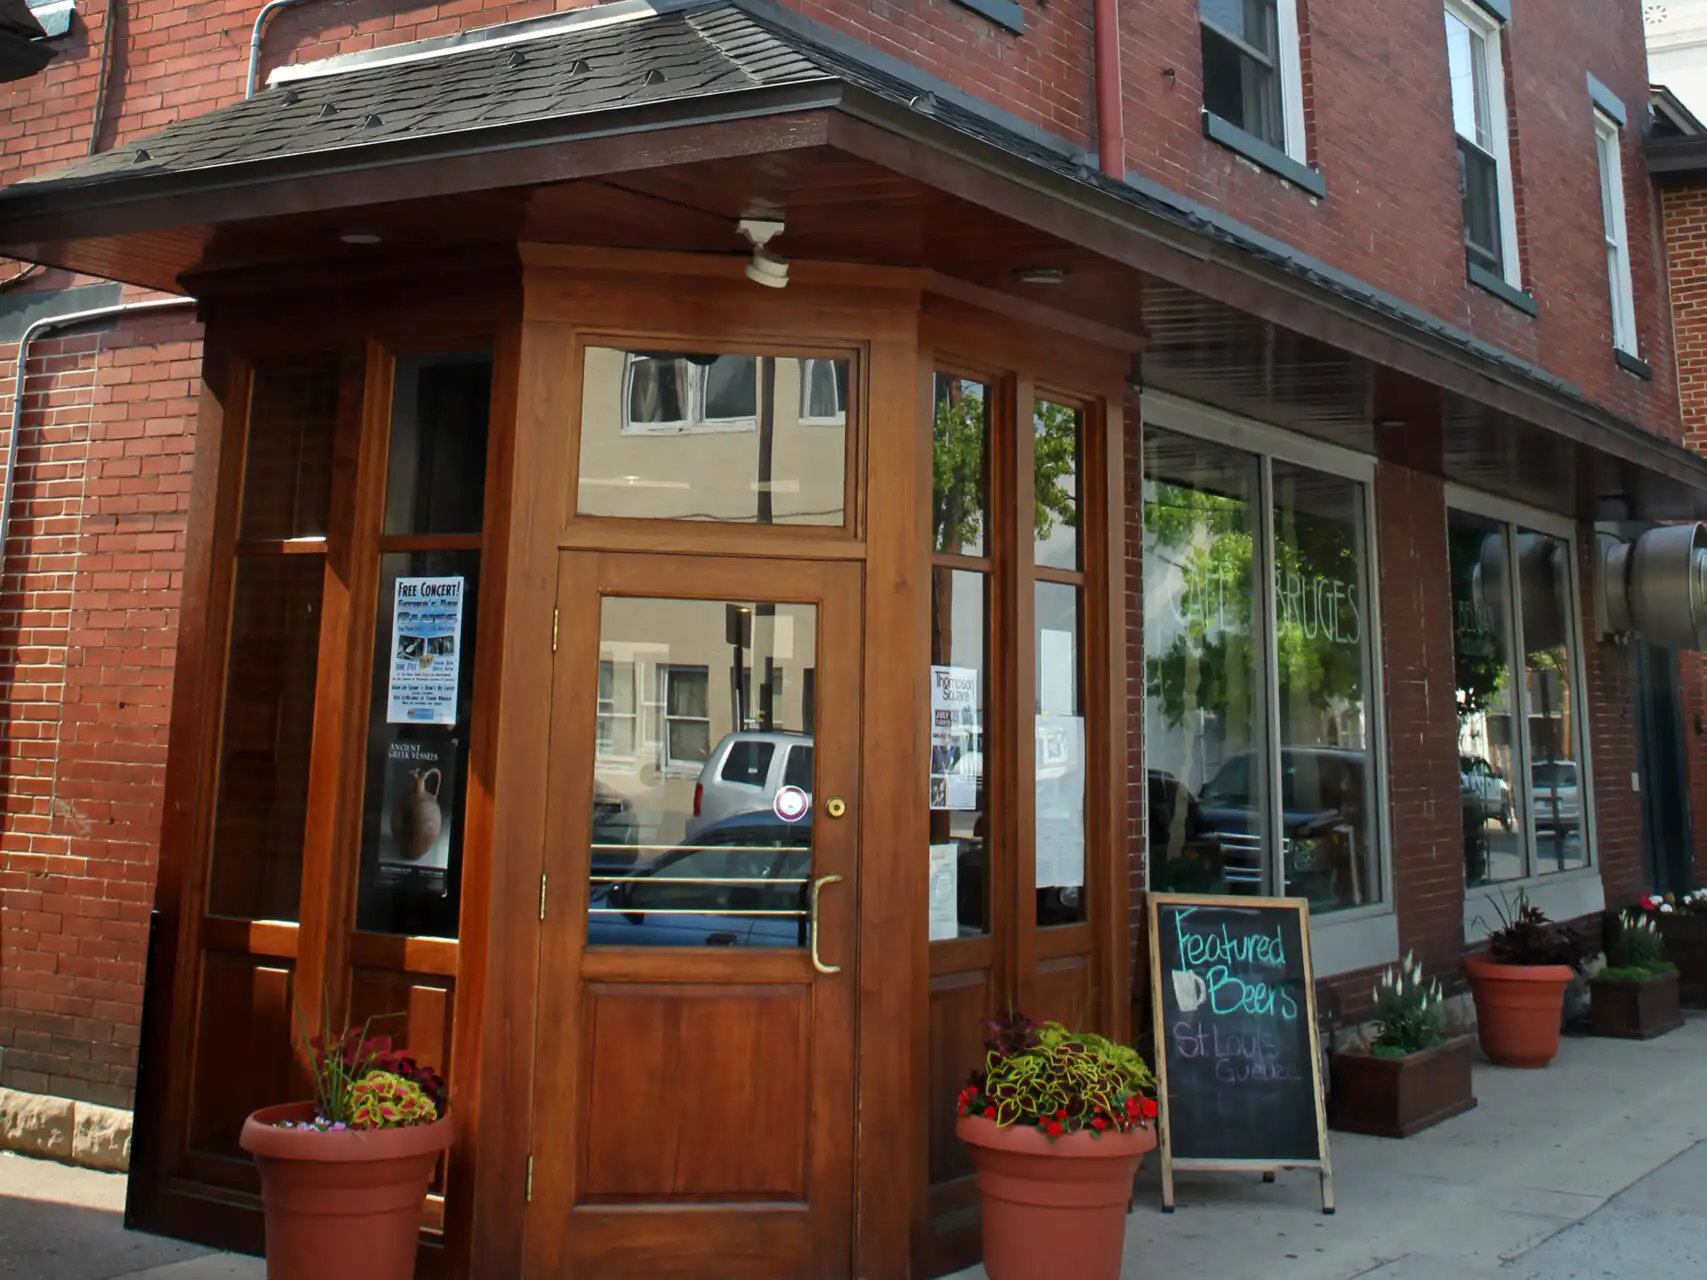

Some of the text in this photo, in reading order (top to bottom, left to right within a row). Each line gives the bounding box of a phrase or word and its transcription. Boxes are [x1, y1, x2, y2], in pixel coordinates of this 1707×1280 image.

[398, 580, 461, 598] FREE CONCERT!
[1174, 906, 1286, 971] Featured
[1206, 964, 1298, 1020] Beers
